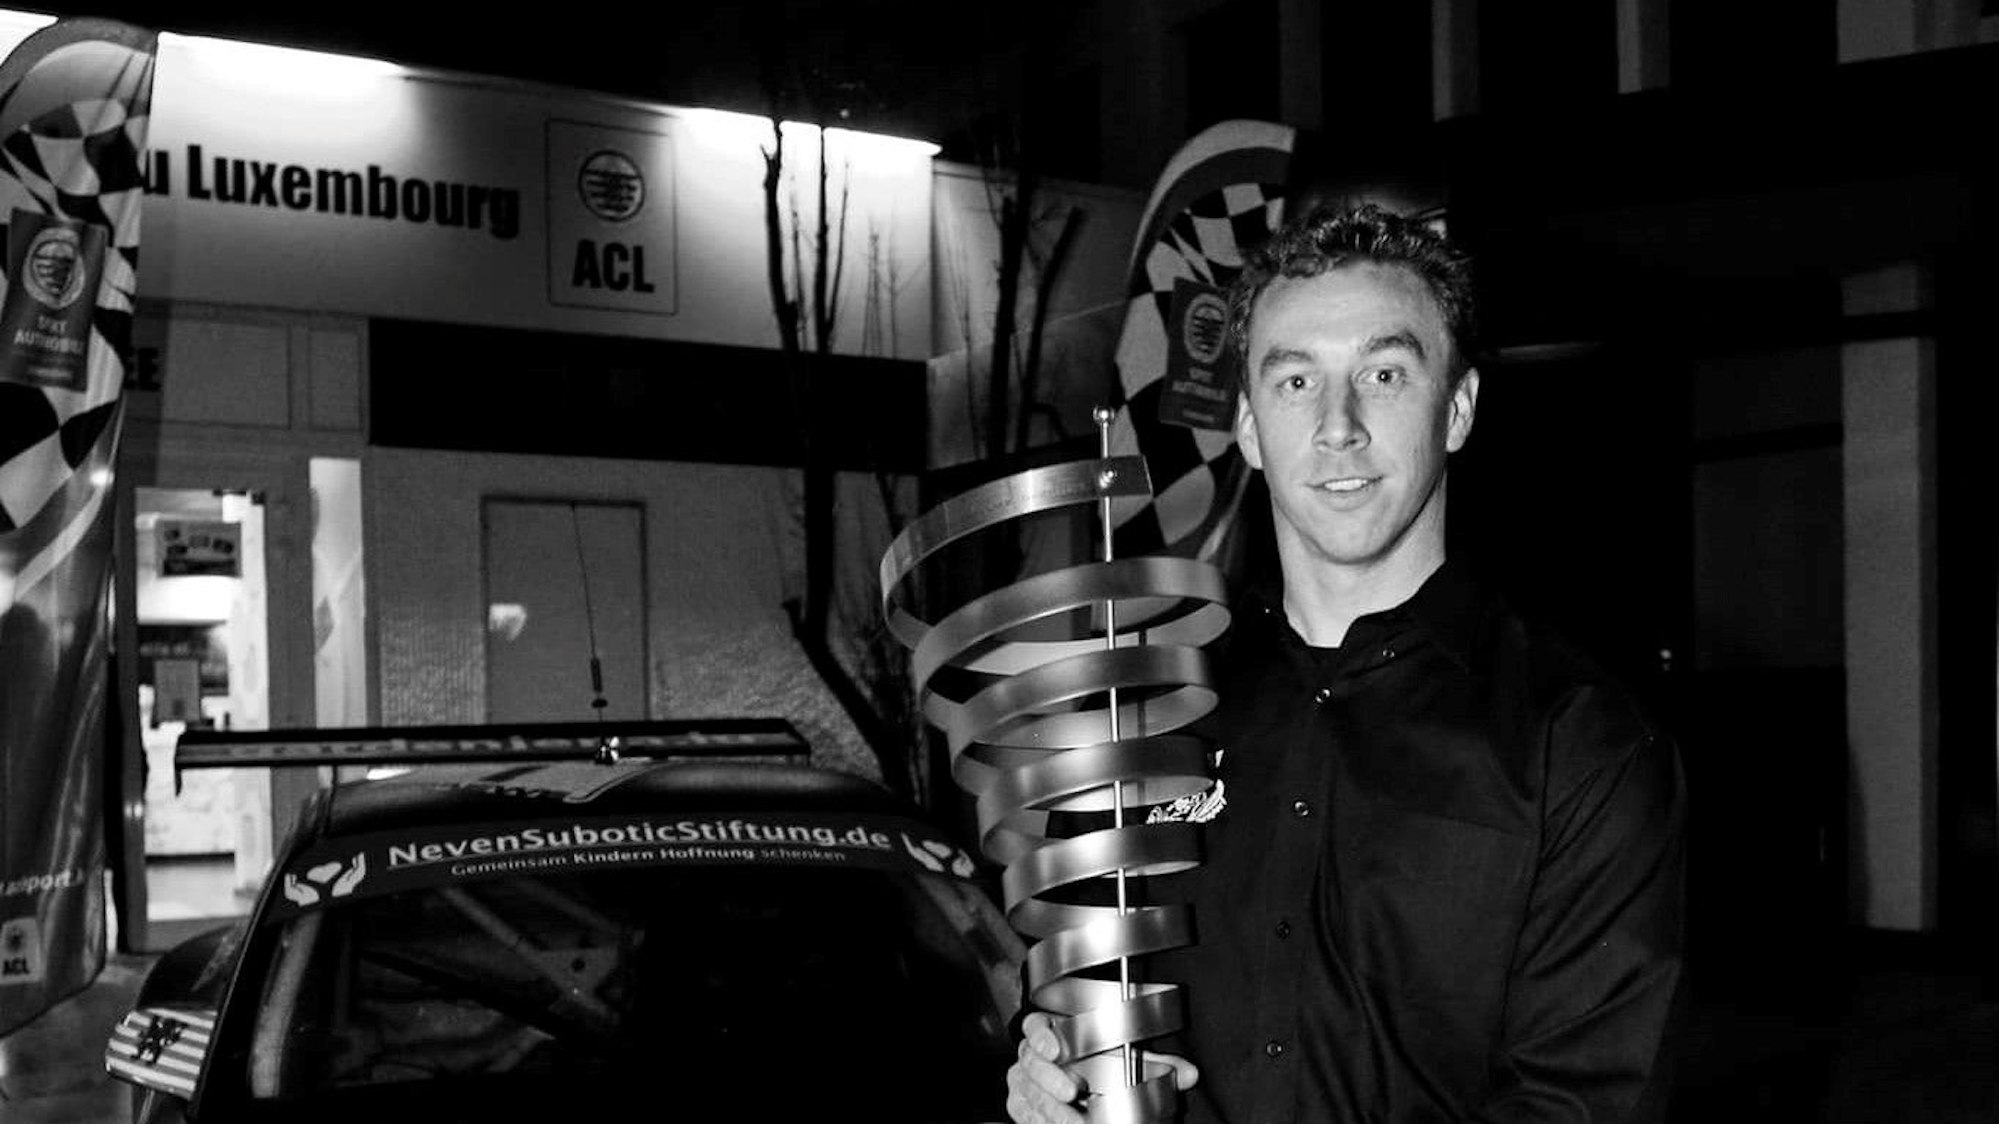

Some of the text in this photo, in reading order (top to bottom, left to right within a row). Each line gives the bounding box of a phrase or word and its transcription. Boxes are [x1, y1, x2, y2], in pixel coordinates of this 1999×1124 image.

[187, 144, 520, 240] Luxembourg
[571, 238, 655, 294] ACL
[387, 820, 892, 867] NevenSuboticStiftung.de
[450, 846, 847, 876] Gemeinsam Kindern Hoffnung schenken
[2, 956, 30, 976] ACL
